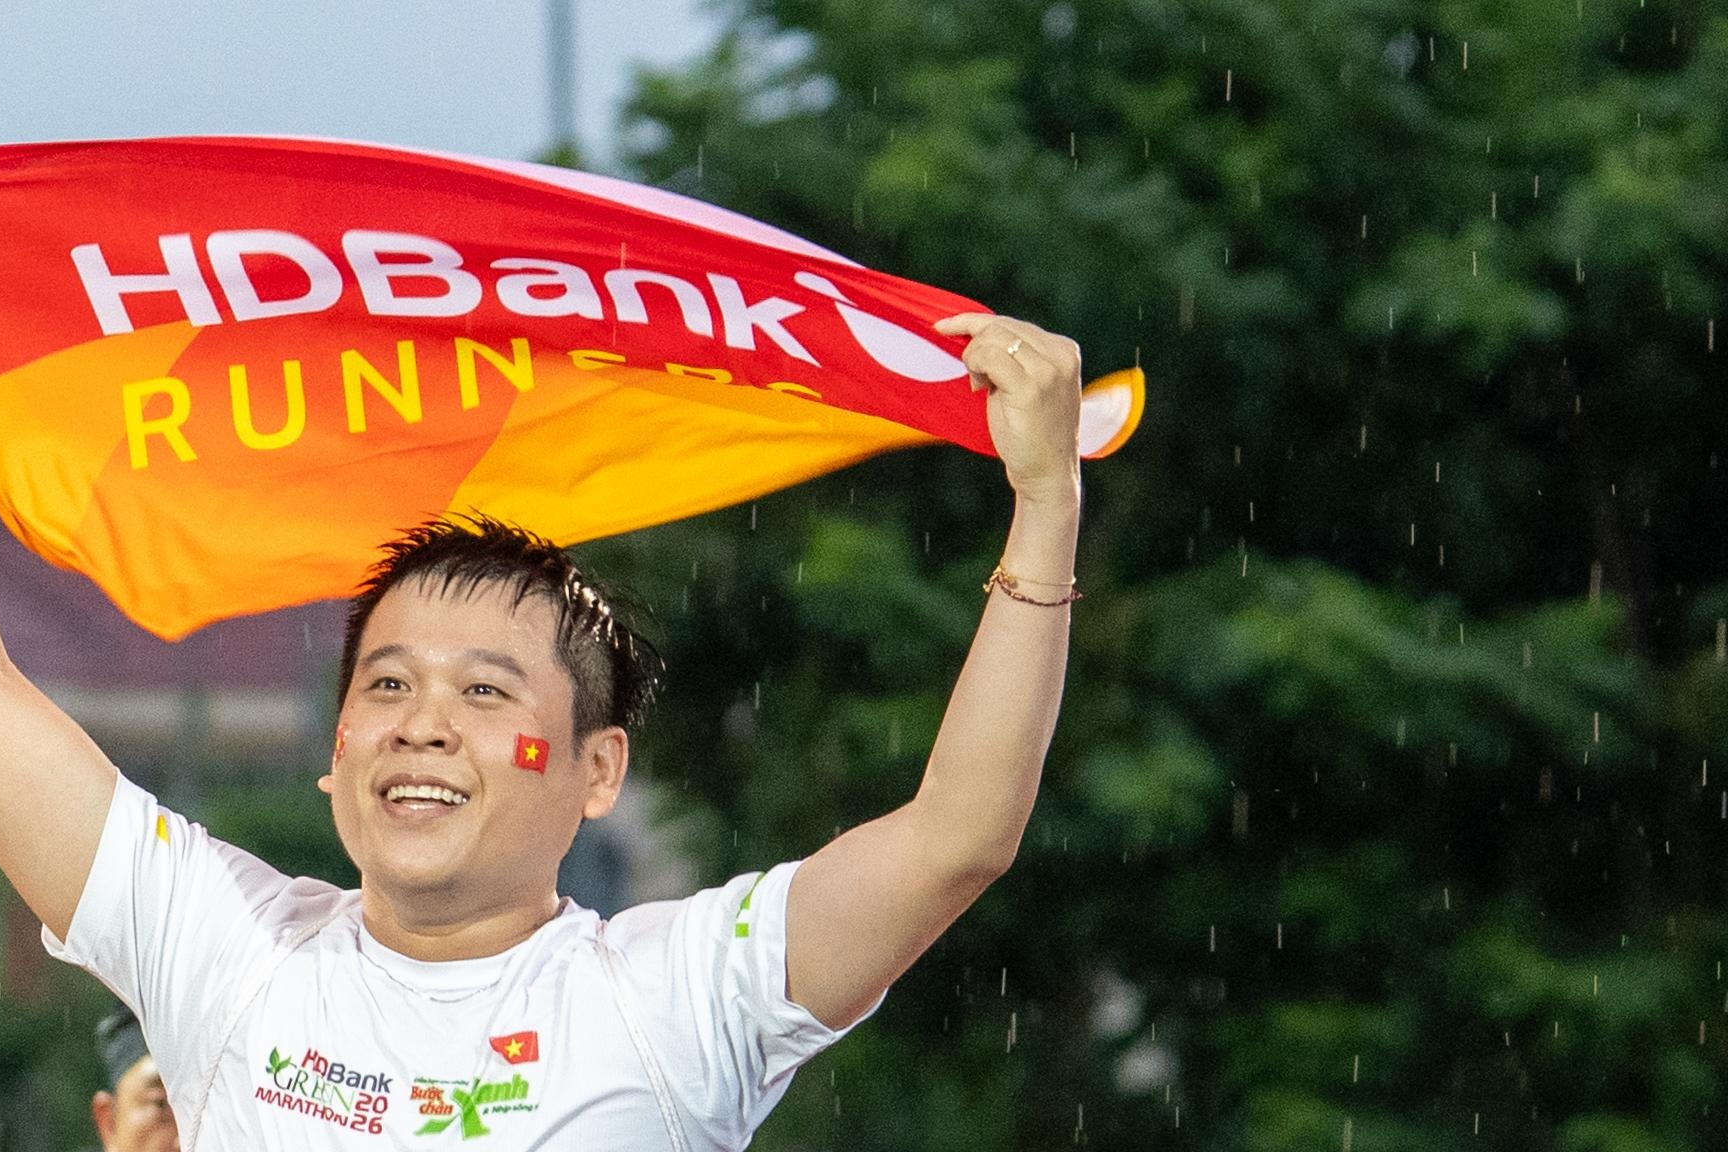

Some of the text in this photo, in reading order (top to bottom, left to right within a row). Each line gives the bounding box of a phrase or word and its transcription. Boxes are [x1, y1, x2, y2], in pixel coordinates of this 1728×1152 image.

[71, 229, 822, 369] HDBank
[122, 336, 823, 471] RUNN
[301, 1048, 394, 1094] HDBank
[254, 1087, 384, 1135] MARATHON 26
[354, 1092, 389, 1116] 20
